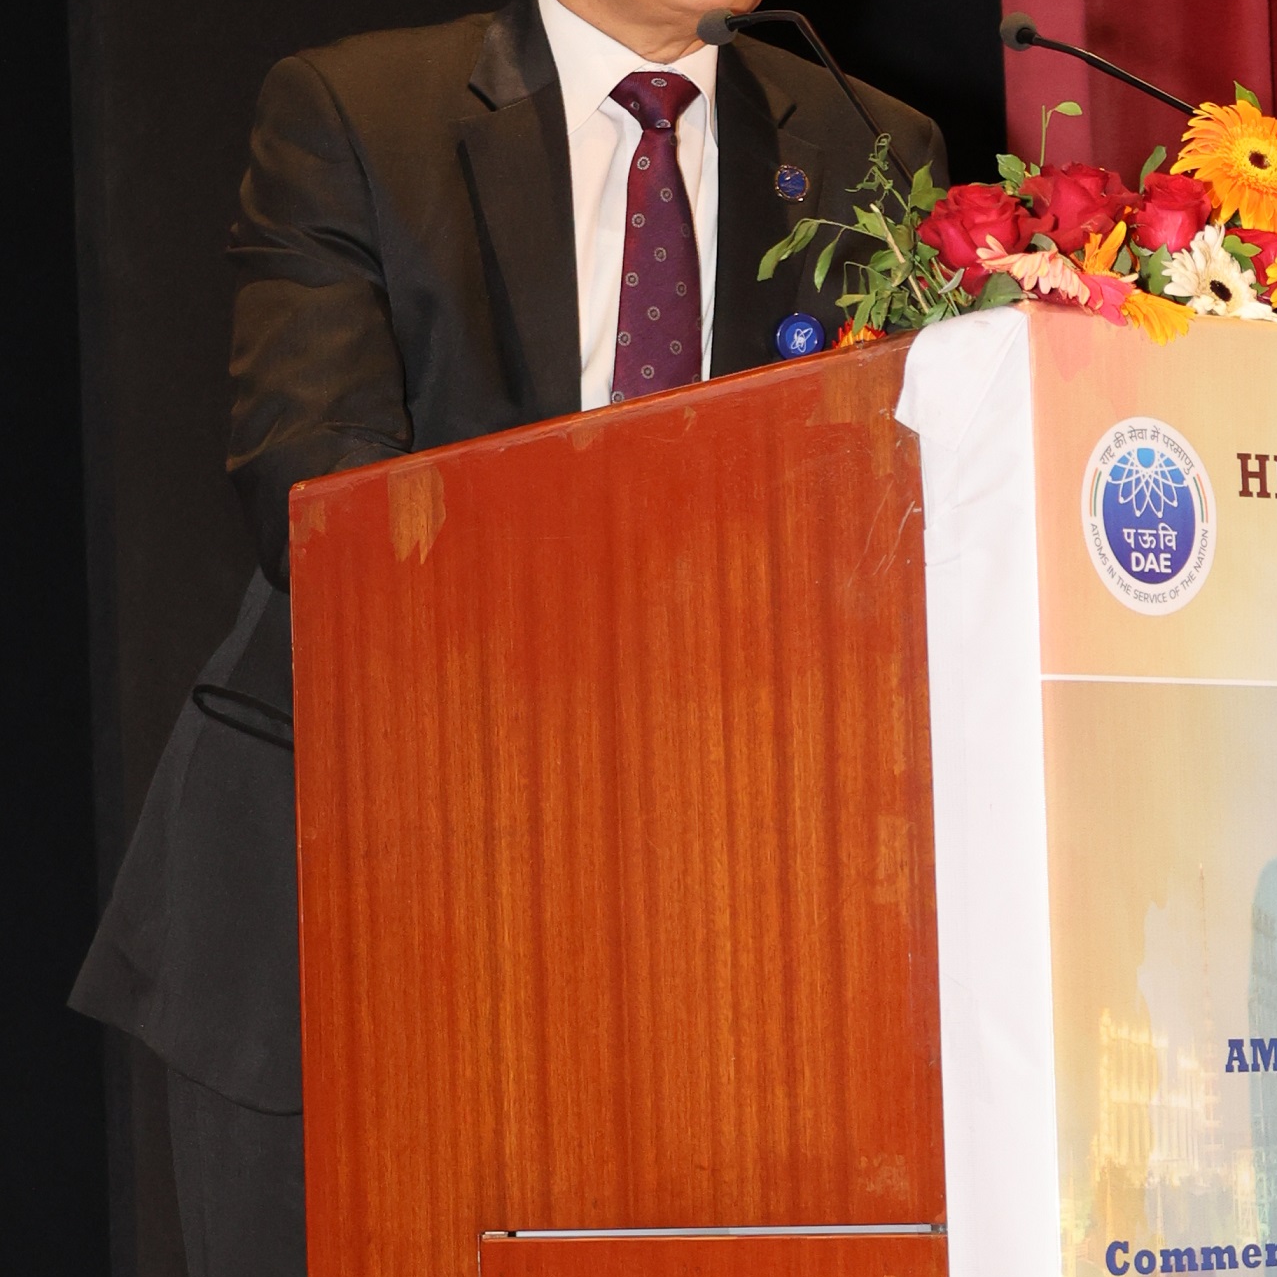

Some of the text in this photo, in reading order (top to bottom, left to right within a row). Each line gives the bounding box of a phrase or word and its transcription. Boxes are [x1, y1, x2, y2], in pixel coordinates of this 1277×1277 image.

[1113, 432, 1127, 446] की
[1128, 425, 1148, 442] सेवा
[1150, 425, 1160, 442] में
[1162, 434, 1195, 475] परमाणु
[1123, 528, 1136, 549] प
[1158, 522, 1177, 551] वि
[1090, 523, 1209, 604] ATOMS IN THE SERVICE OF THE NATION
[1131, 552, 1172, 573] DAE
